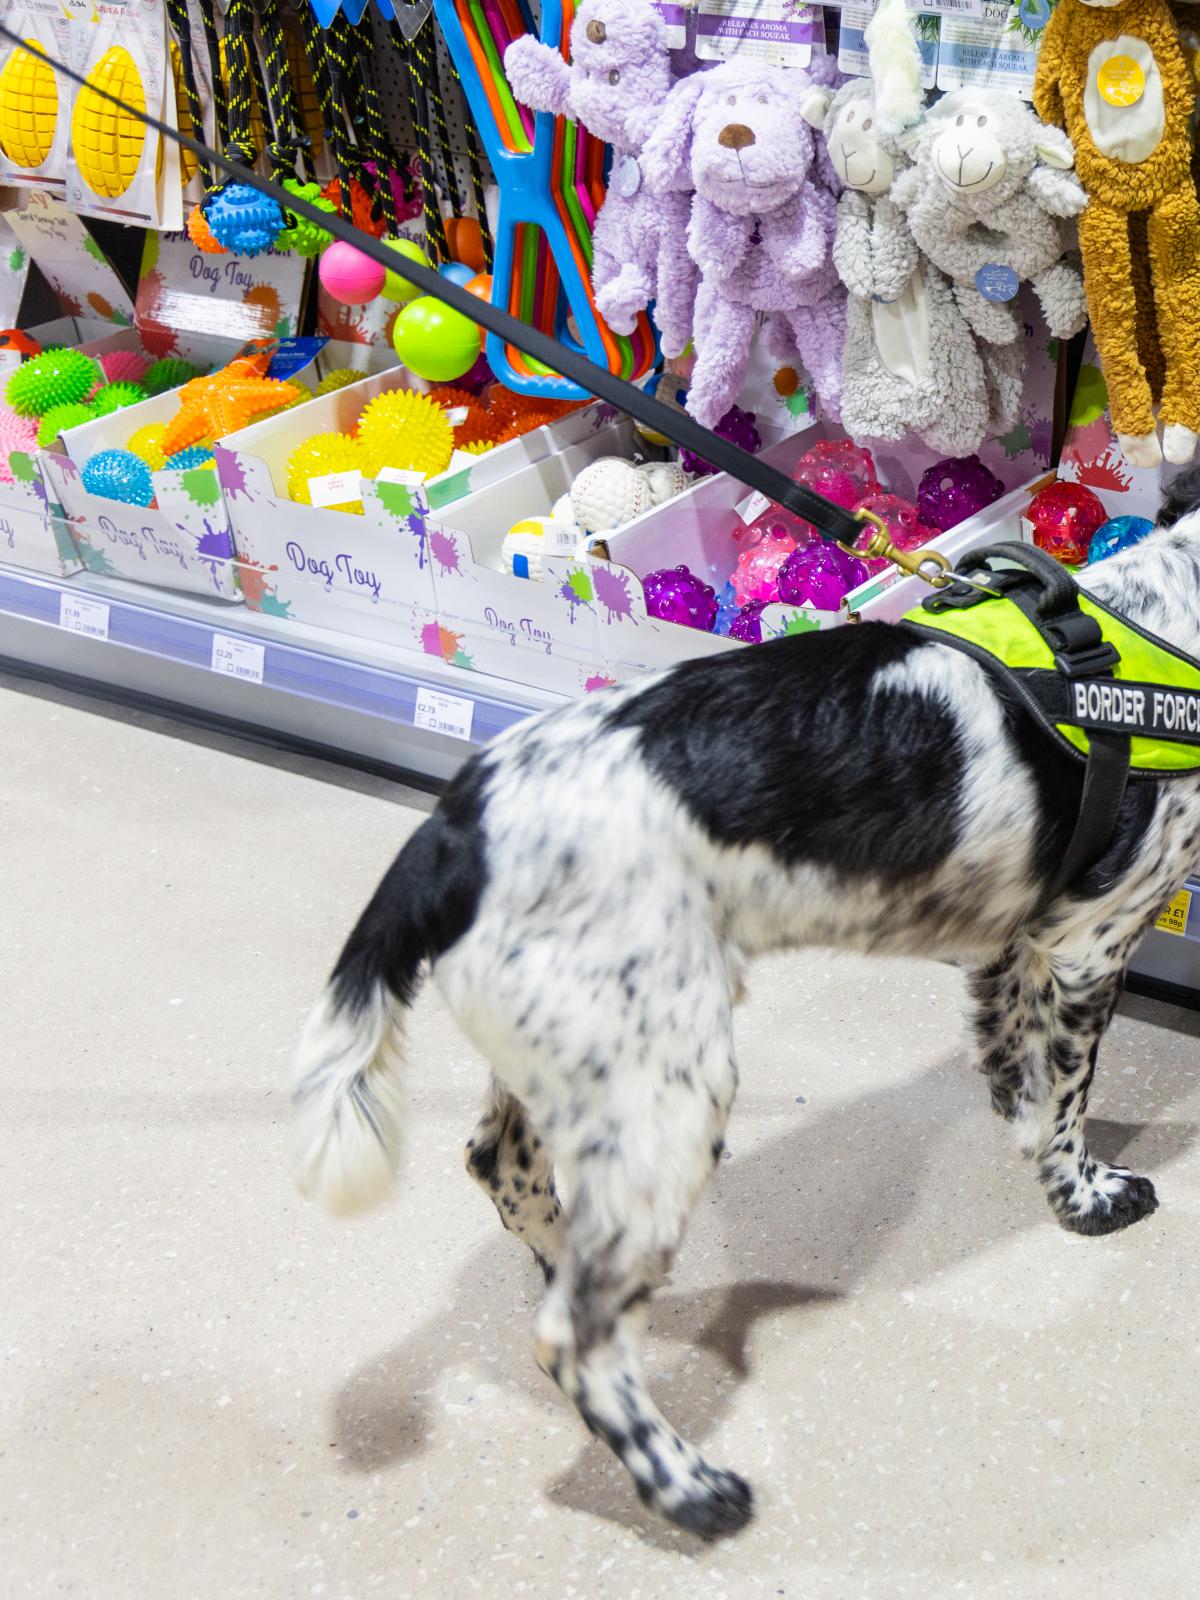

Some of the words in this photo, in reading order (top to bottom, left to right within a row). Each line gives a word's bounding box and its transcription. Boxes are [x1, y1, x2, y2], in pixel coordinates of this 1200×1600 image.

[985, 7, 1009, 19] DOG
[719, 27, 738, 35] WITH
[739, 29, 759, 37] EACH
[760, 30, 790, 40] SQUEAK
[760, 23, 787, 32] AROMA
[962, 49, 998, 59] RELEASES
[1000, 53, 1025, 62] AROMA
[998, 61, 1028, 72] SQUEAK
[190, 255, 221, 293] Dog
[225, 261, 255, 291] Toy
[98, 515, 147, 560] Dog
[141, 526, 188, 570] Toy
[286, 541, 334, 593] Dog
[335, 554, 381, 604] Toy
[484, 607, 516, 646] Dog
[520, 618, 552, 655] Toy
[1074, 683, 1145, 726] BORDER
[1173, 908, 1184, 919] £1
[1169, 919, 1182, 928] 98p
